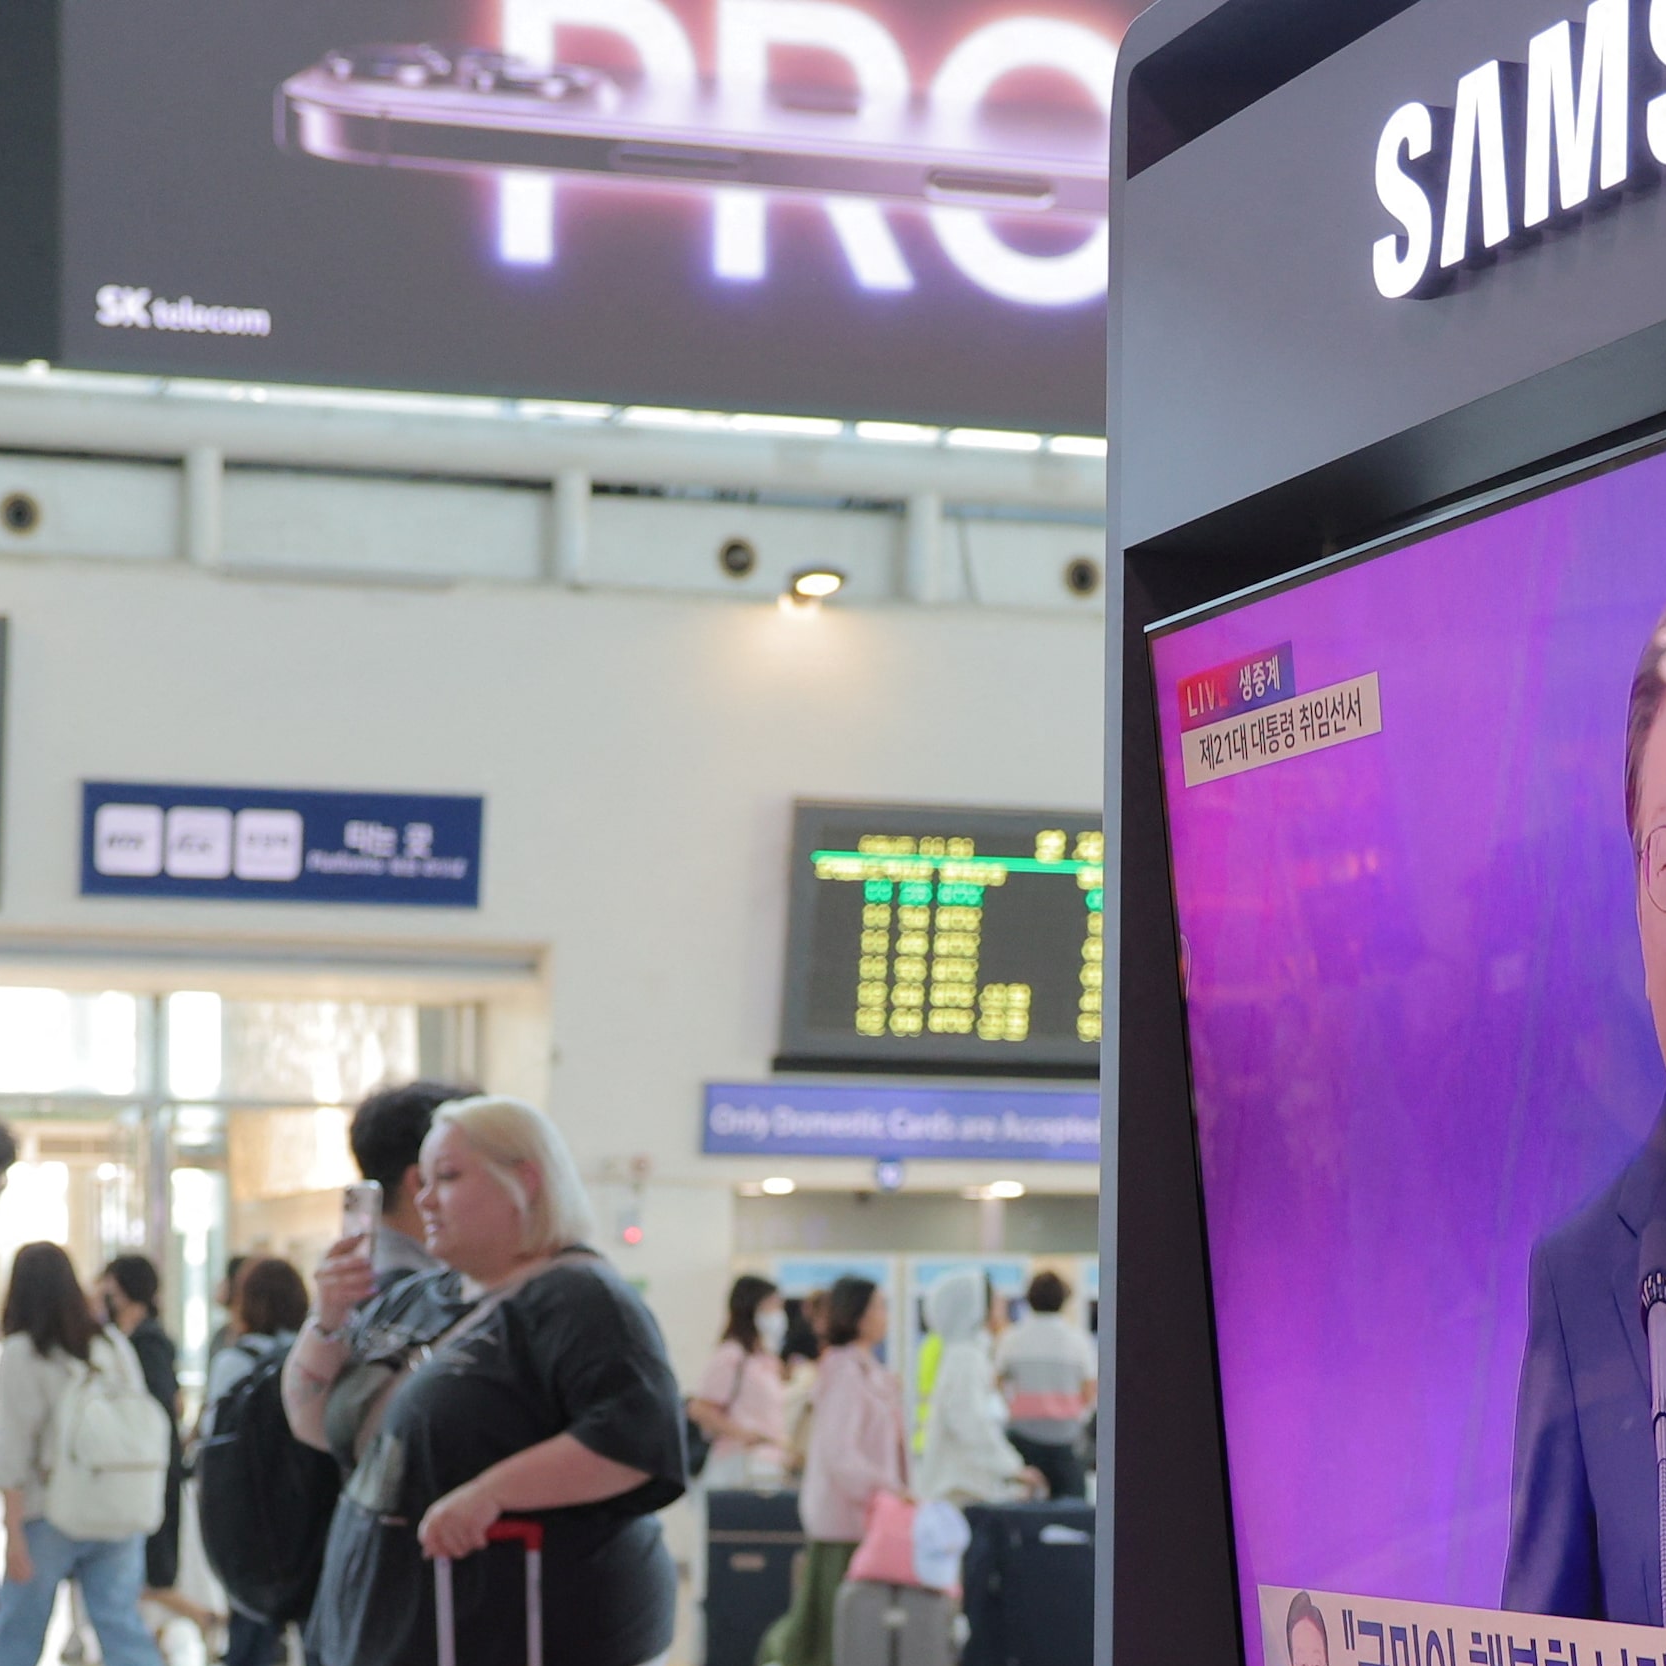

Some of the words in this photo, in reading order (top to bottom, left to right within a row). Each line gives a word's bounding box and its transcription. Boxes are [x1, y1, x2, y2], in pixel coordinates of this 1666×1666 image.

[95, 284, 152, 329] SK
[1239, 654, 1281, 702] 생중계
[1199, 722, 1248, 771] 제21대
[1251, 707, 1296, 755] 대통령
[1299, 686, 1363, 743] 취임선서
